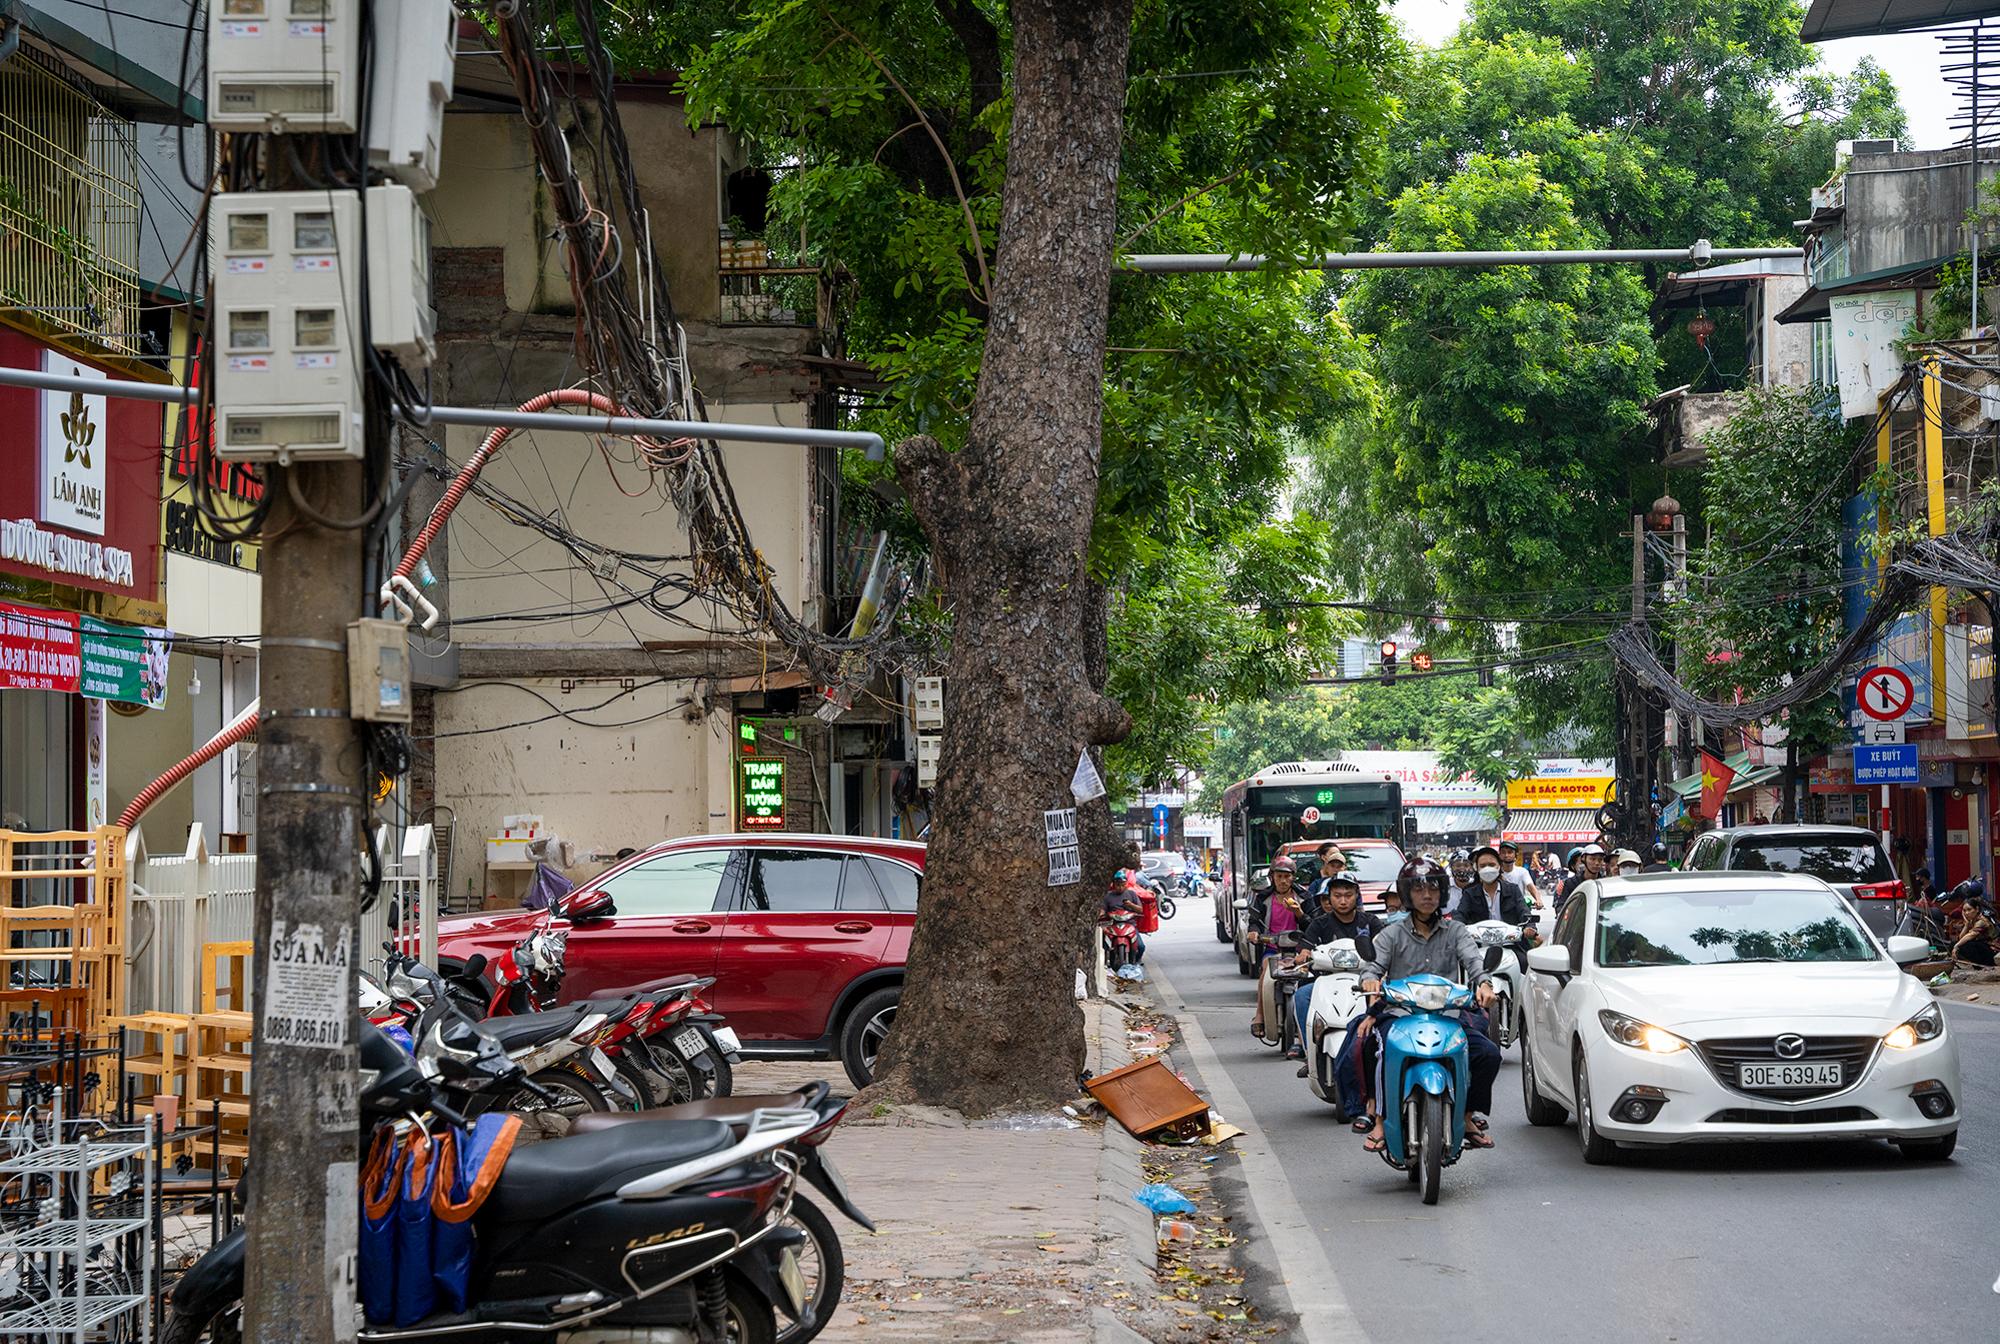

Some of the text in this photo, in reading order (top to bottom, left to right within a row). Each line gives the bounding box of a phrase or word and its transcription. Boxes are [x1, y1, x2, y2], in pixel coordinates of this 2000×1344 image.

[53, 471, 101, 511] LÂM ANH
[166, 498, 194, 553] 958
[55, 533, 91, 577] SINH
[91, 543, 105, 580] &
[105, 547, 134, 587] SPA
[29, 614, 46, 640] KHAI
[1871, 749, 1901, 762] XE BUÝT
[744, 763, 782, 775] TRANH
[1872, 766, 1886, 778] PHÉP
[751, 777, 775, 790] DÁN
[1525, 784, 1536, 794] LÊ
[1560, 785, 1596, 793] MOTOR
[1046, 813, 1064, 831] MUA
[1305, 810, 1318, 820] 49
[1050, 851, 1066, 870] MUA
[1744, 1065, 1839, 1085] 30E-639.45
[626, 1222, 705, 1249] LEAD
